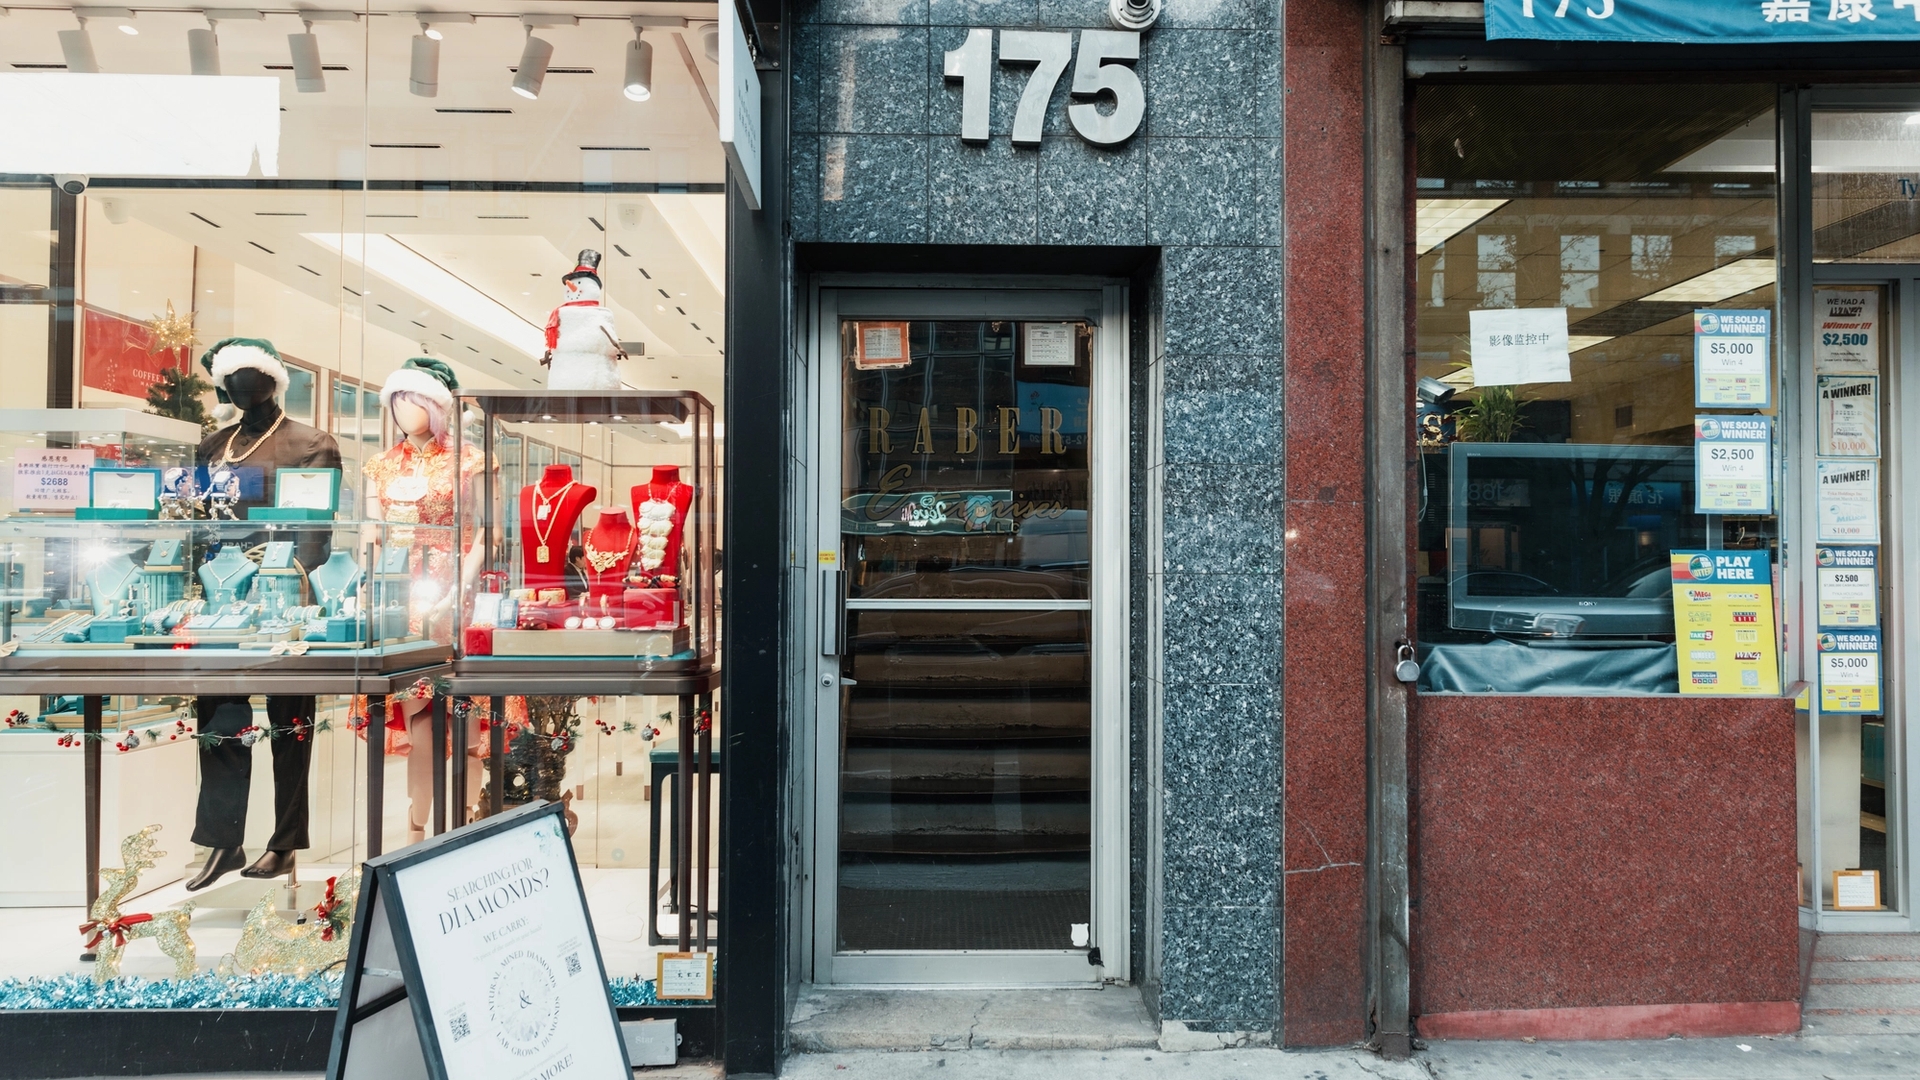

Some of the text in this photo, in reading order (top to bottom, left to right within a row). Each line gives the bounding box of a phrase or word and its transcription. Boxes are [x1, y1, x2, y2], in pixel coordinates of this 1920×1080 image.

[944, 29, 1145, 144] 175
[1720, 324, 1765, 333] WINNER!
[1489, 333, 1549, 347] 影像监控中
[1823, 332, 1868, 346] $2,500
[1710, 342, 1753, 356] $5,000
[132, 368, 160, 383] COFFEE
[1822, 383, 1871, 399] A WINNER!
[868, 406, 1067, 455] RABER
[1721, 421, 1766, 429] WE SOLD A
[1721, 430, 1766, 439] WINNER!
[1711, 448, 1754, 461] $2,500
[41, 477, 68, 486] $2688
[1822, 469, 1870, 484] A WINNER!
[1716, 556, 1751, 567] PLAY
[1836, 557, 1874, 565] WINNER!
[1717, 568, 1754, 579] HERE
[1837, 642, 1877, 650] WINNER!
[1830, 658, 1868, 669] $5,000
[447, 857, 533, 903] SEARCHING FOR
[438, 867, 549, 935] DIAMONDS?
[483, 916, 530, 944] WE CARRY:
[488, 950, 557, 1022] NATURAL MINED DIAMONDS
[519, 990, 532, 1009] &
[496, 996, 560, 1057] LAB GROWN DIAMONDS
[540, 1053, 574, 1080] MORE!
